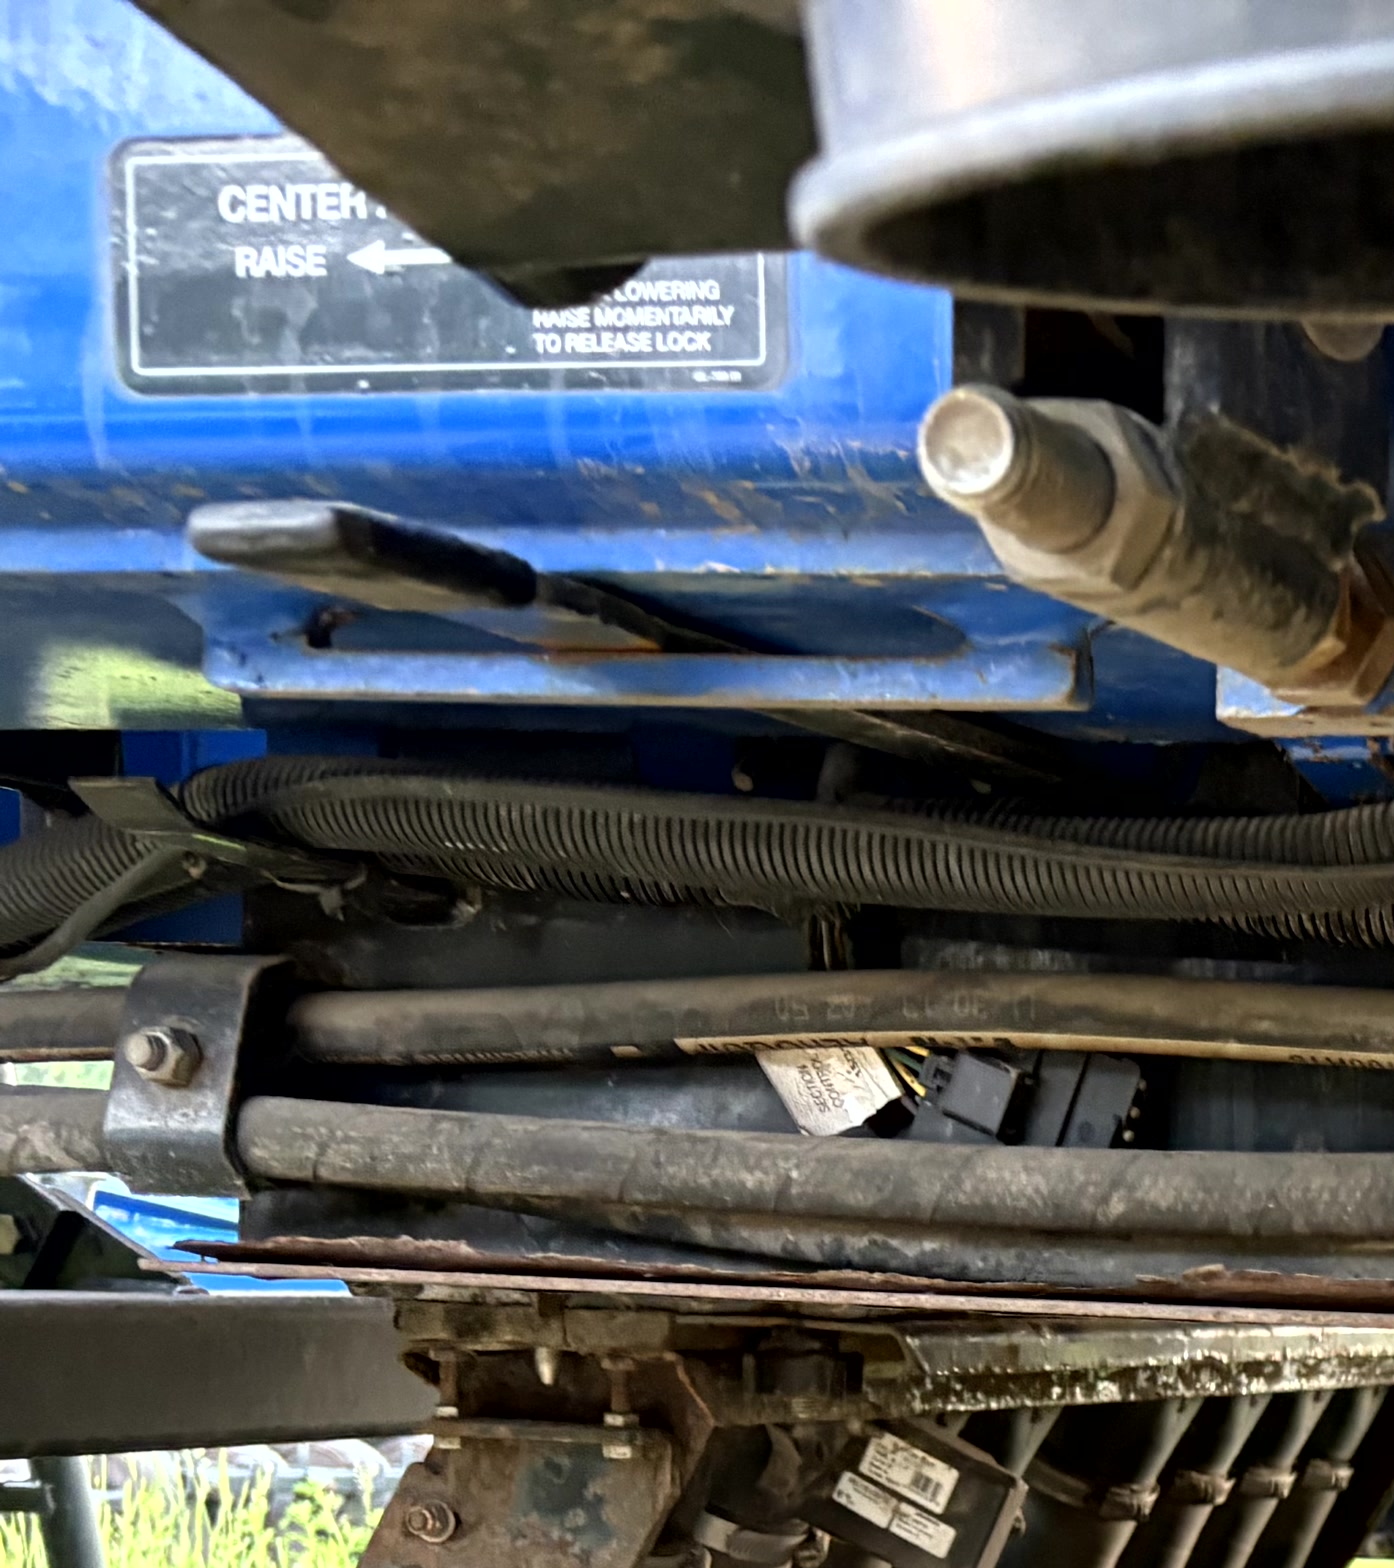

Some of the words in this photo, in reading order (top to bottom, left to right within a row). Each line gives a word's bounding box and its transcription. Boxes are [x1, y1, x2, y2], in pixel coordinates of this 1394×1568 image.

[218, 183, 367, 223] CENTER
[235, 245, 327, 278] RAISE
[532, 307, 590, 329] RAISE
[595, 304, 735, 327] MOMENTARILY
[532, 333, 561, 354] TO
[564, 332, 652, 353] RELEASE
[656, 331, 711, 352] LOCK
